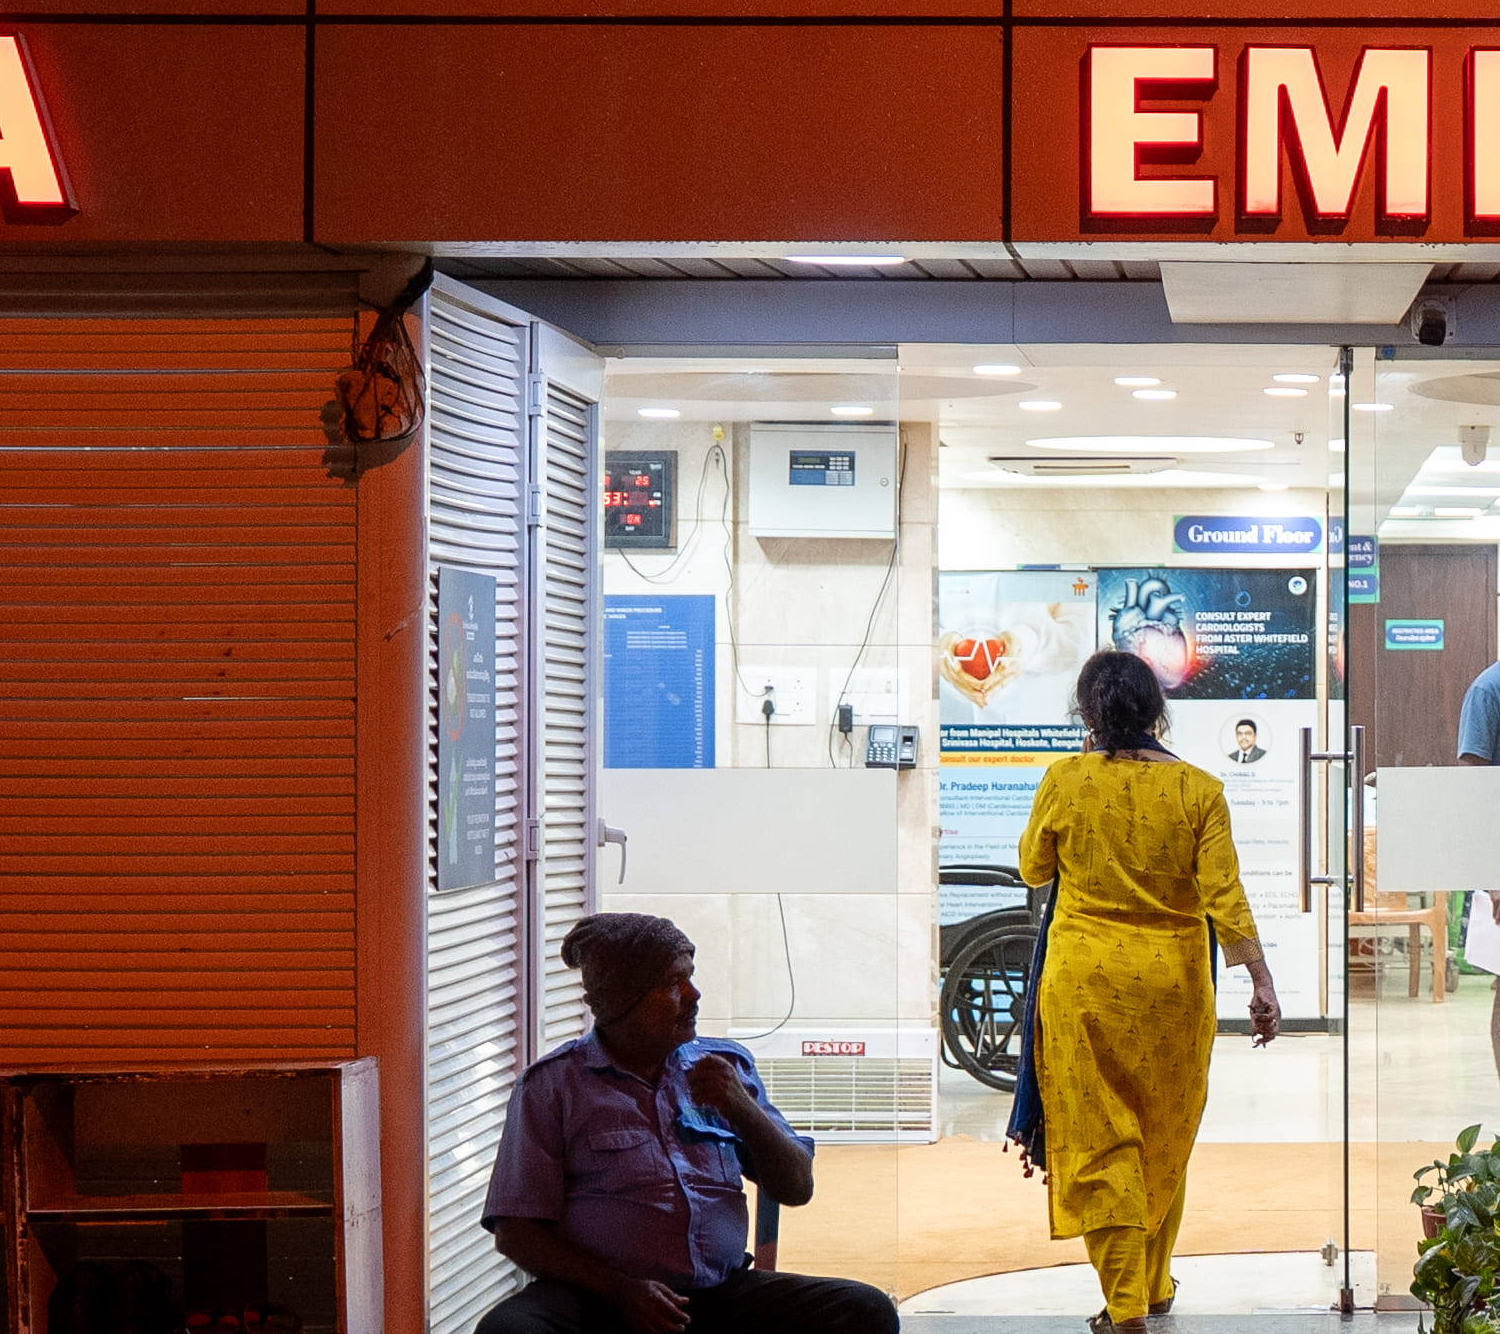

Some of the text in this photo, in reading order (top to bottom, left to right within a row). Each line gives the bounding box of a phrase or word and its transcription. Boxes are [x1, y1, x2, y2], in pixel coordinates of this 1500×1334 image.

[1187, 524, 1315, 544] Ground Floor
[1195, 611, 1272, 621] CONSULT EXPERT
[1195, 623, 1265, 633] CARDIOLOGISTS
[1195, 634, 1309, 644] FROM ASTER WHITEFIELD
[1195, 645, 1239, 655] HOSPITAL
[983, 755, 1008, 765] expert
[1010, 755, 1035, 764] doctor
[951, 781, 989, 792] Pradeep
[991, 781, 1038, 791] Haranahal
[802, 1042, 864, 1054] PESTOP
